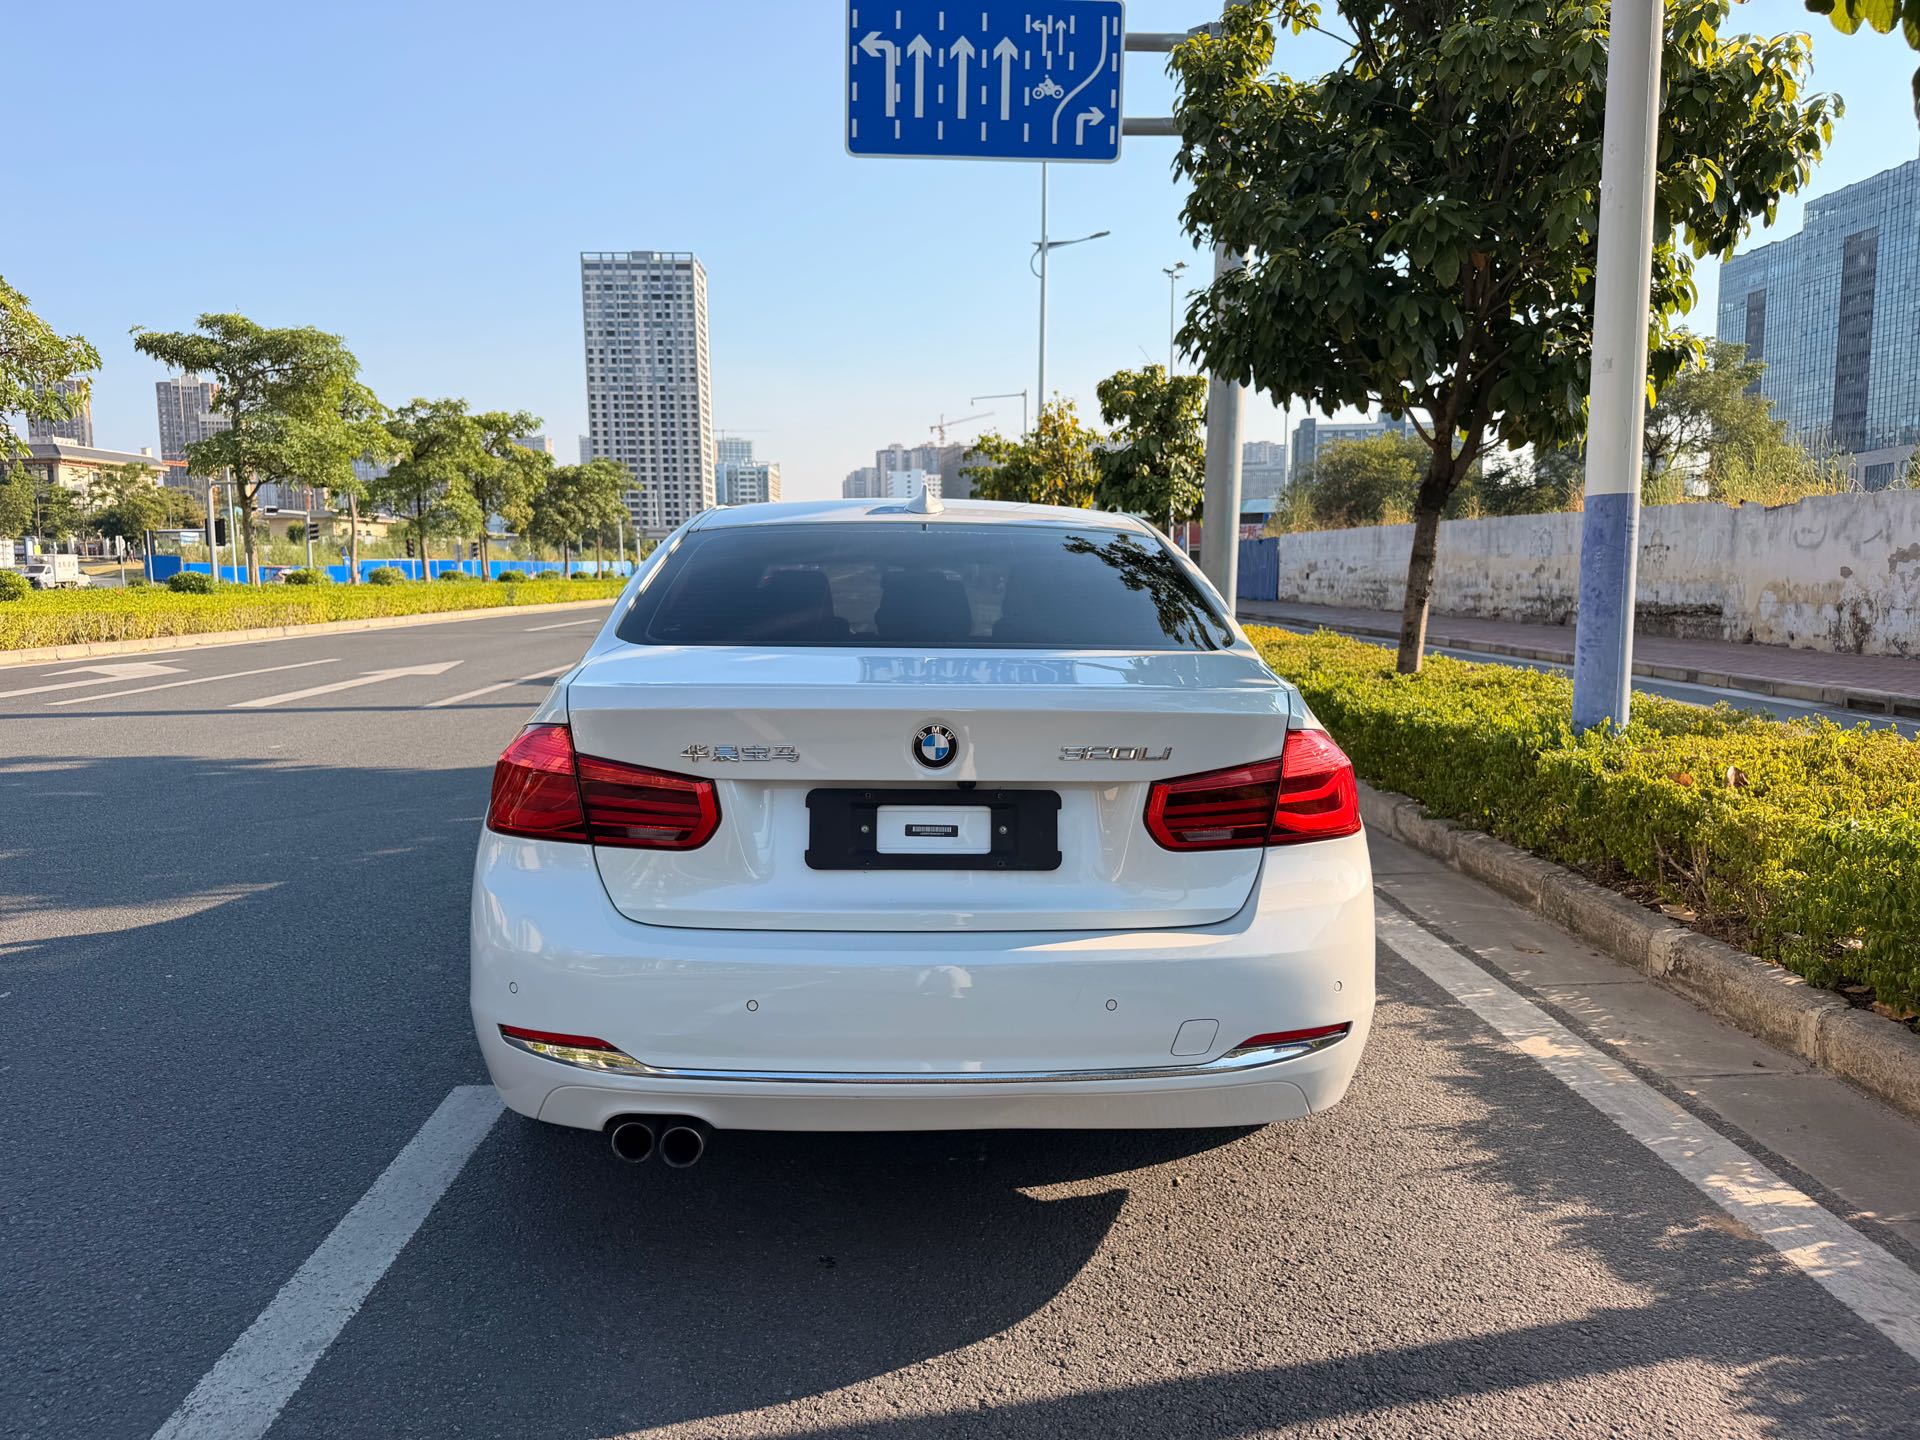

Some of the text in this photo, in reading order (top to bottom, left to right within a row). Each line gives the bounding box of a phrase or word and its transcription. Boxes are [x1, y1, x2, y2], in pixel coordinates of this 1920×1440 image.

[917, 726, 955, 741] BMW
[680, 744, 800, 762] 华晨宝马
[1059, 746, 1173, 761] 320Li
